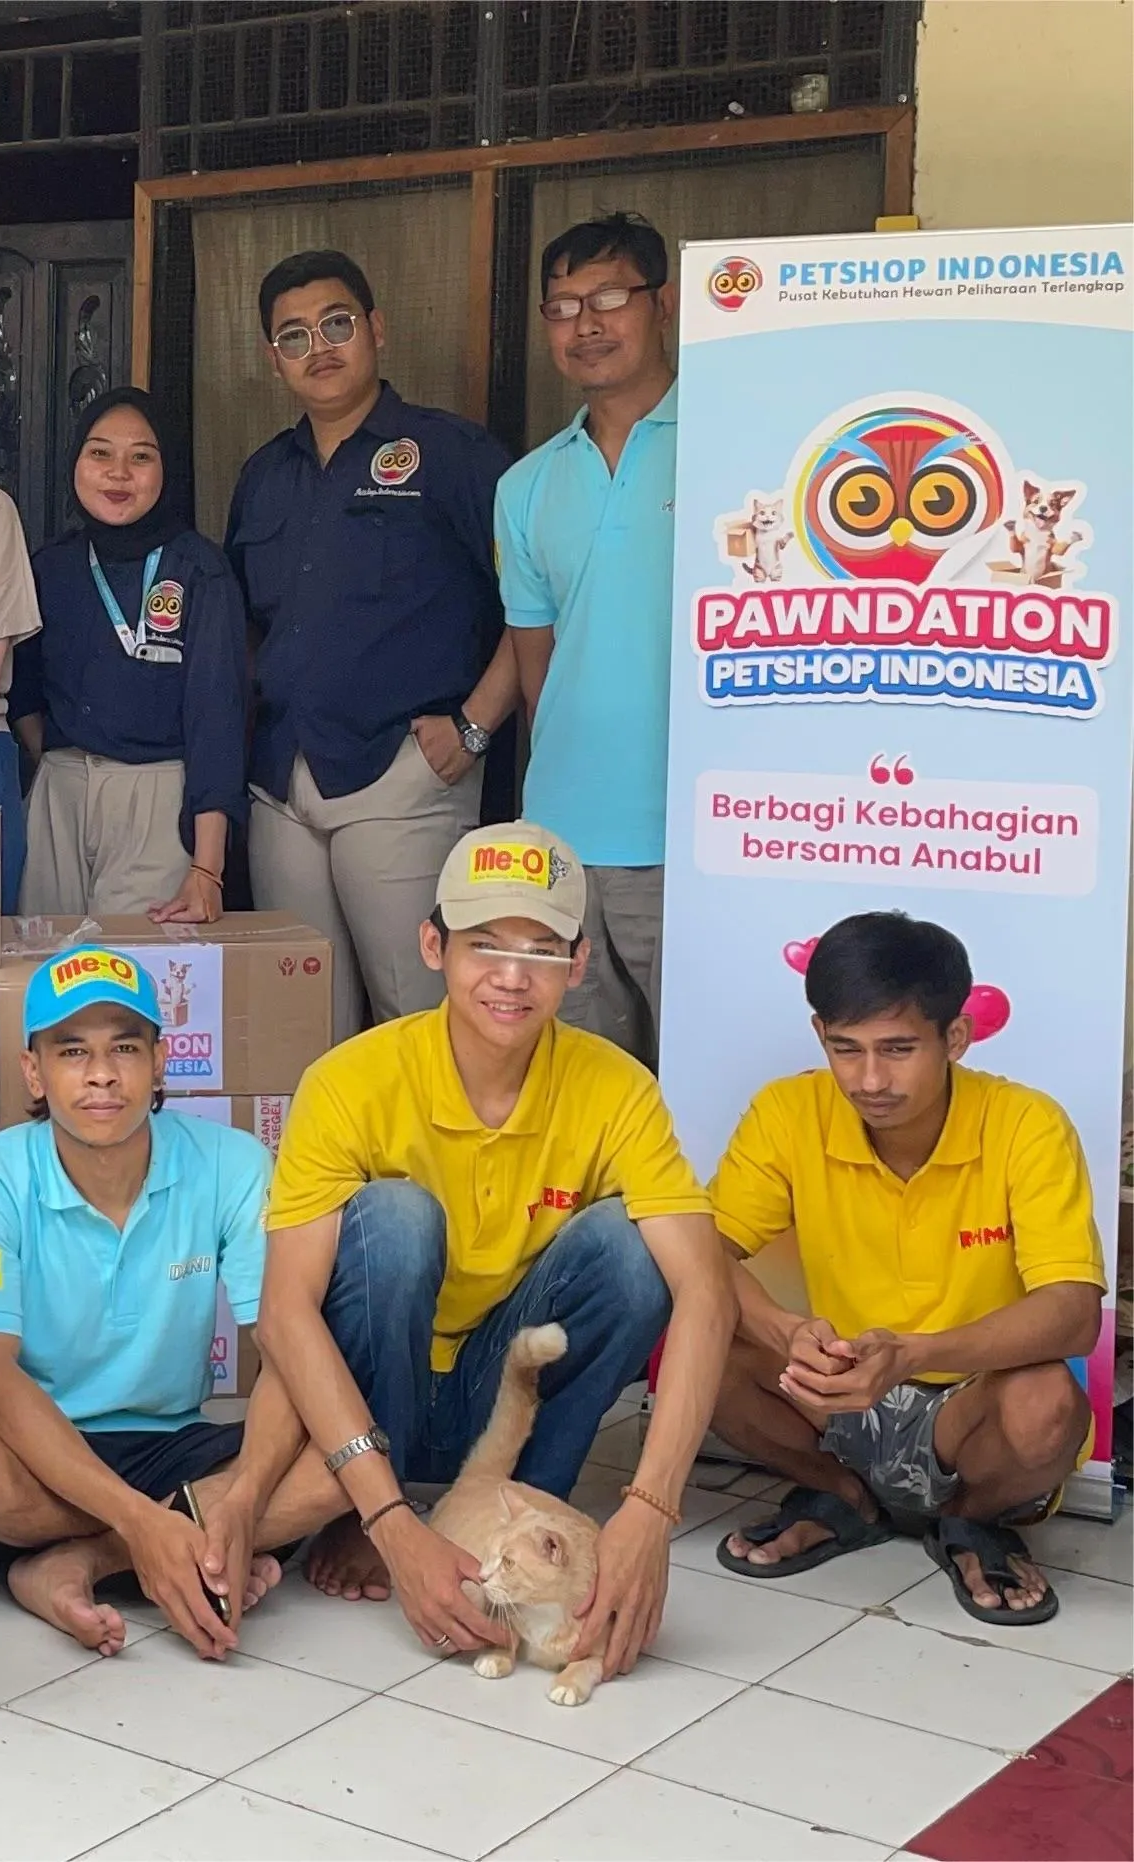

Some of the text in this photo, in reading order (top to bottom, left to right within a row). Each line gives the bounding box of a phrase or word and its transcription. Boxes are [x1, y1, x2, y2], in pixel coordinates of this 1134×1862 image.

[779, 251, 1124, 287] PETSHOP INDONESIA
[779, 279, 1124, 302] Pusat Kebutuhan Hewan Peliharaan Terlengkap
[703, 592, 1103, 649] PAWNDATION
[712, 654, 1089, 700] PETSHOP INDONESIA
[712, 793, 1079, 841] Berbagi Kebahagian
[742, 832, 1042, 875] bersama Anabul
